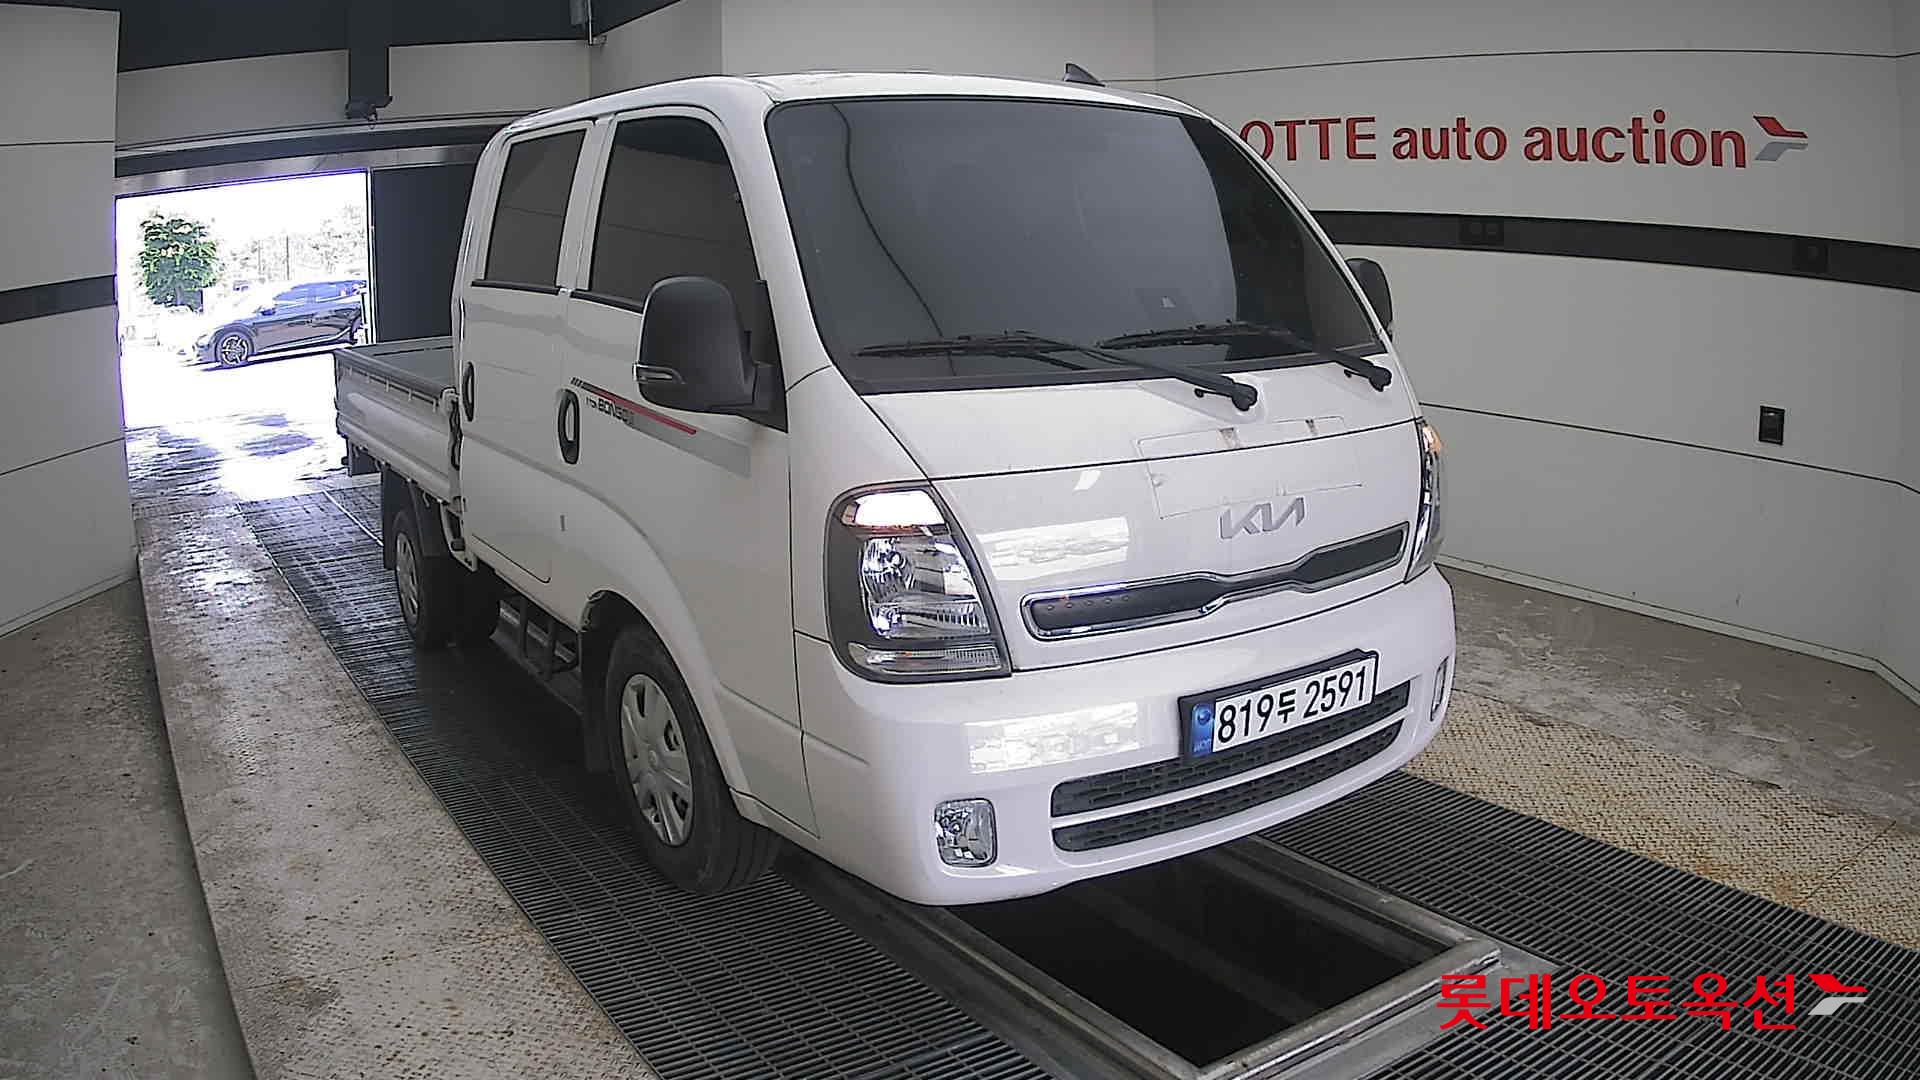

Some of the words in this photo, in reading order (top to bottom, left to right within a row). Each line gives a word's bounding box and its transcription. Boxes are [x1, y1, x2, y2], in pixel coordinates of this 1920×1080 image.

[1239, 116, 1377, 161] OTTE
[1392, 117, 1508, 162] auto
[1523, 109, 1747, 169] auction
[1217, 688, 1297, 744] 819두
[1303, 665, 1369, 719] 2591
